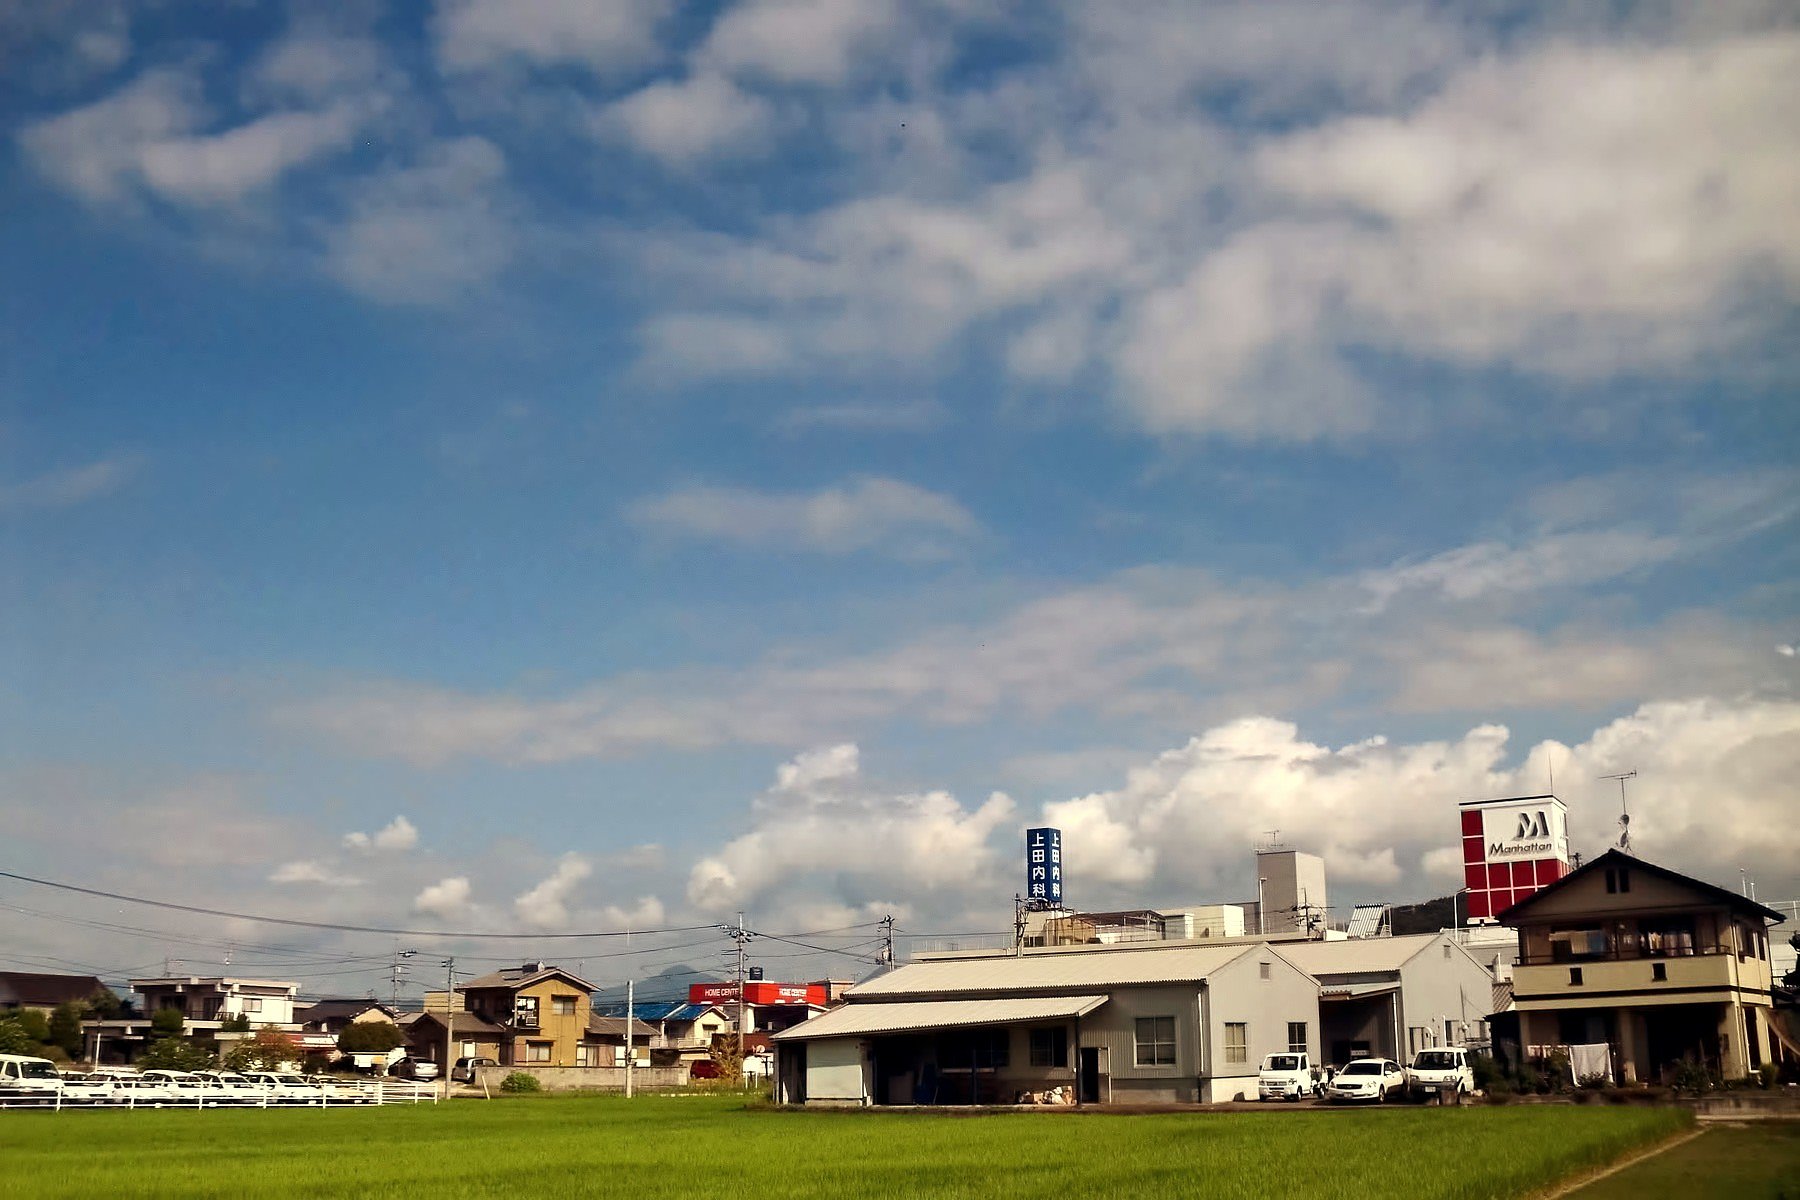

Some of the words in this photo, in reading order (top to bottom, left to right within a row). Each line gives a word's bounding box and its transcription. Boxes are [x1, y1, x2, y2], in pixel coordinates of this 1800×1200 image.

[1032, 833, 1046, 897] 上田内科
[1052, 833, 1060, 897] 上田内科
[1490, 842, 1552, 854] Manhattan
[705, 989, 720, 997] HOME
[721, 988, 740, 996] CENTE
